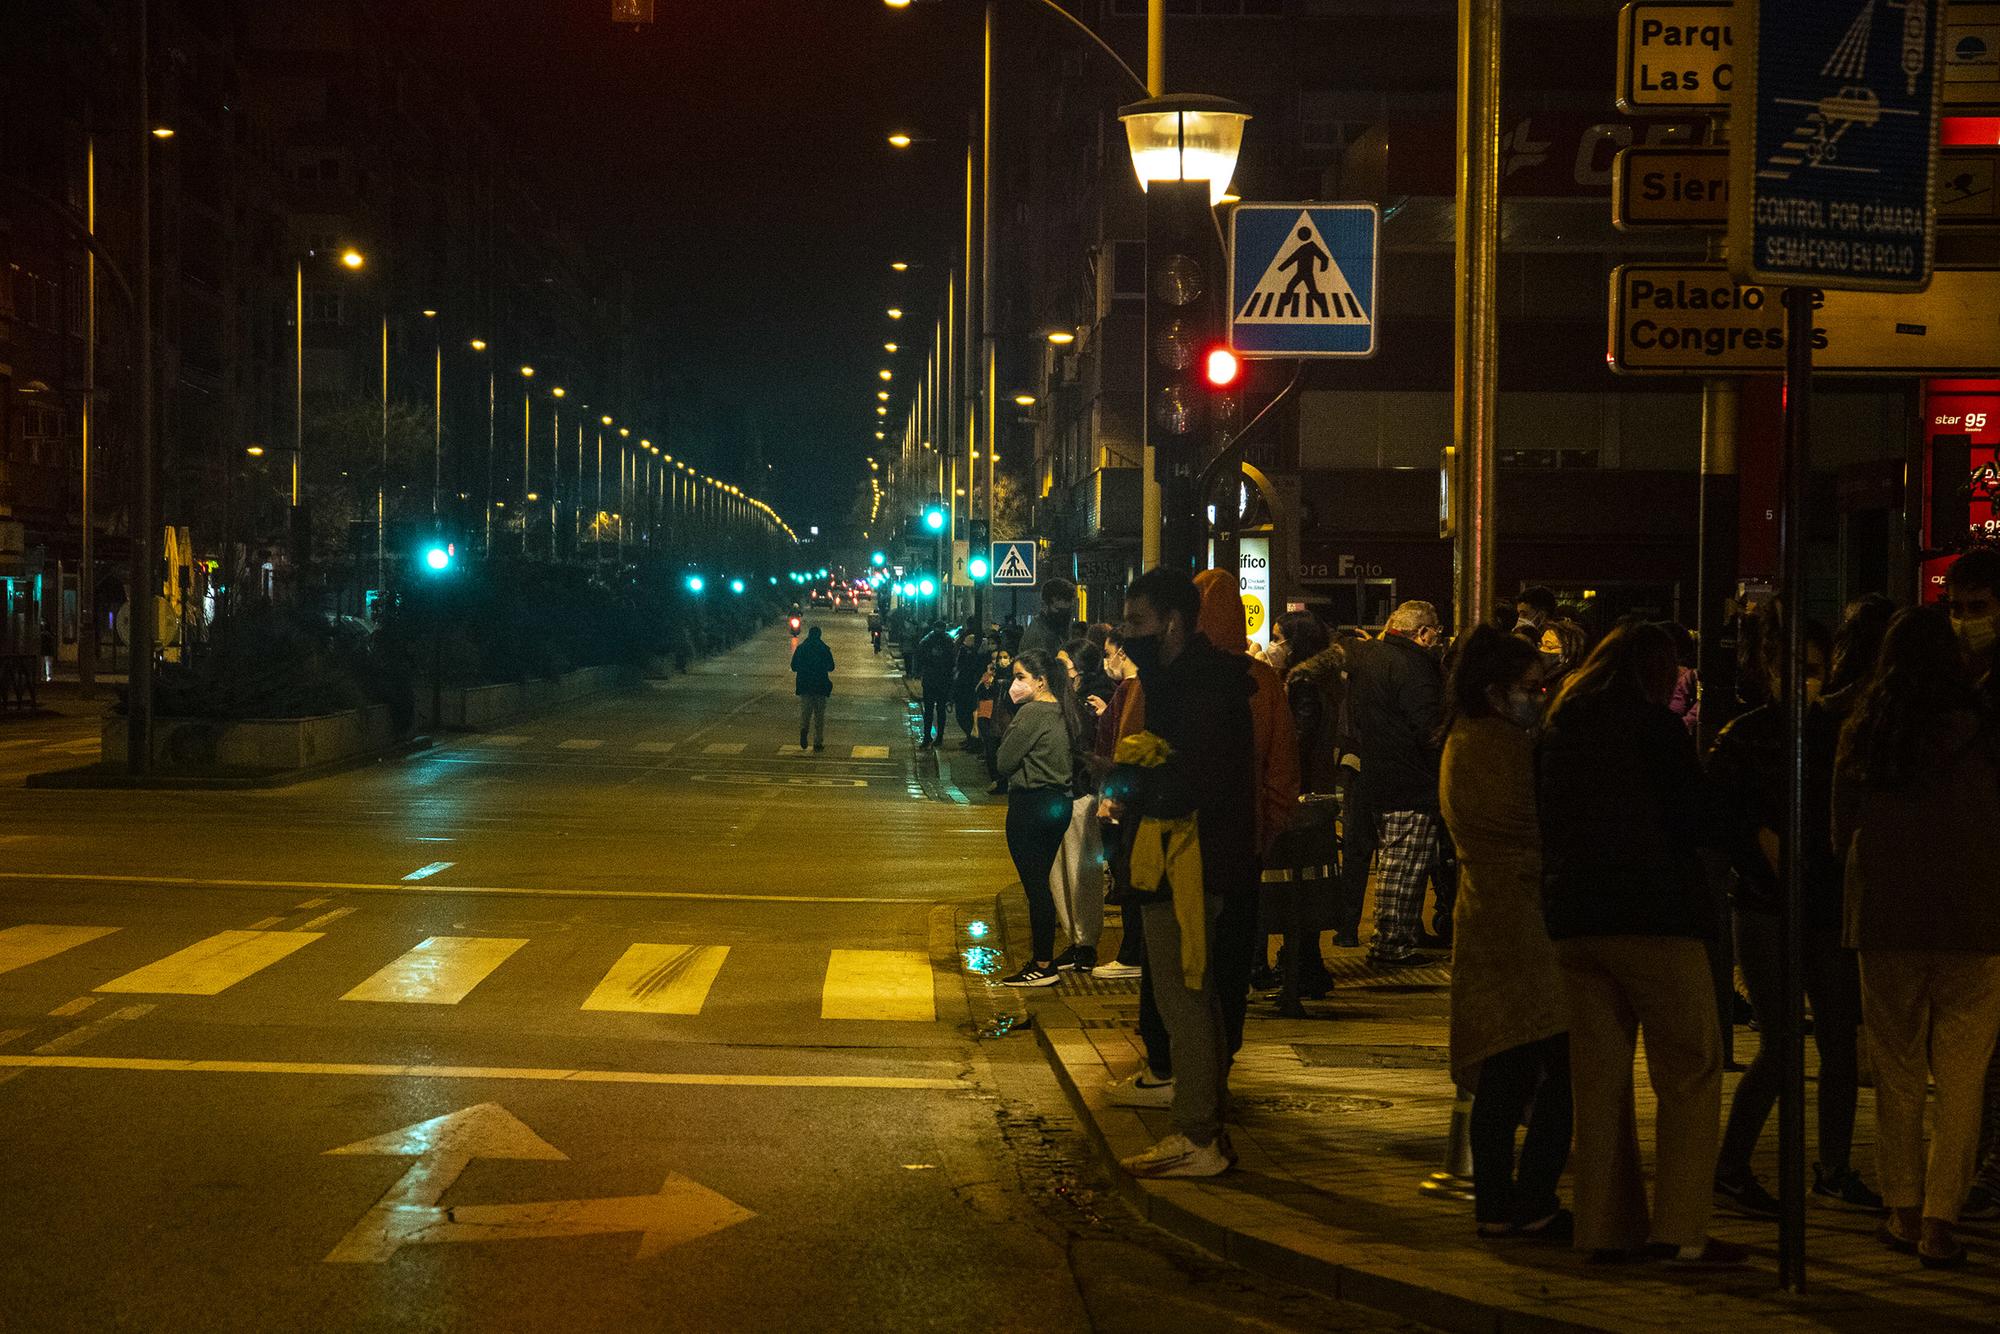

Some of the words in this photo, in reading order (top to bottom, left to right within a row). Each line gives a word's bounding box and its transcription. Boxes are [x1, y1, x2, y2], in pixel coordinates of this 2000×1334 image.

[1641, 64, 1700, 91] Las
[1642, 172, 1728, 202] Sier
[1757, 196, 1826, 229] CONTROL
[1828, 202, 1861, 232] POR
[1852, 240, 1872, 273] EN
[1874, 242, 1915, 275] ROJO
[1631, 280, 1765, 310] Palacio
[1630, 319, 1828, 356] Congress
[1935, 414, 1961, 425] star
[1964, 413, 1987, 428] 95
[1240, 554, 1266, 568] ífico
[1248, 617, 1254, 627] €
